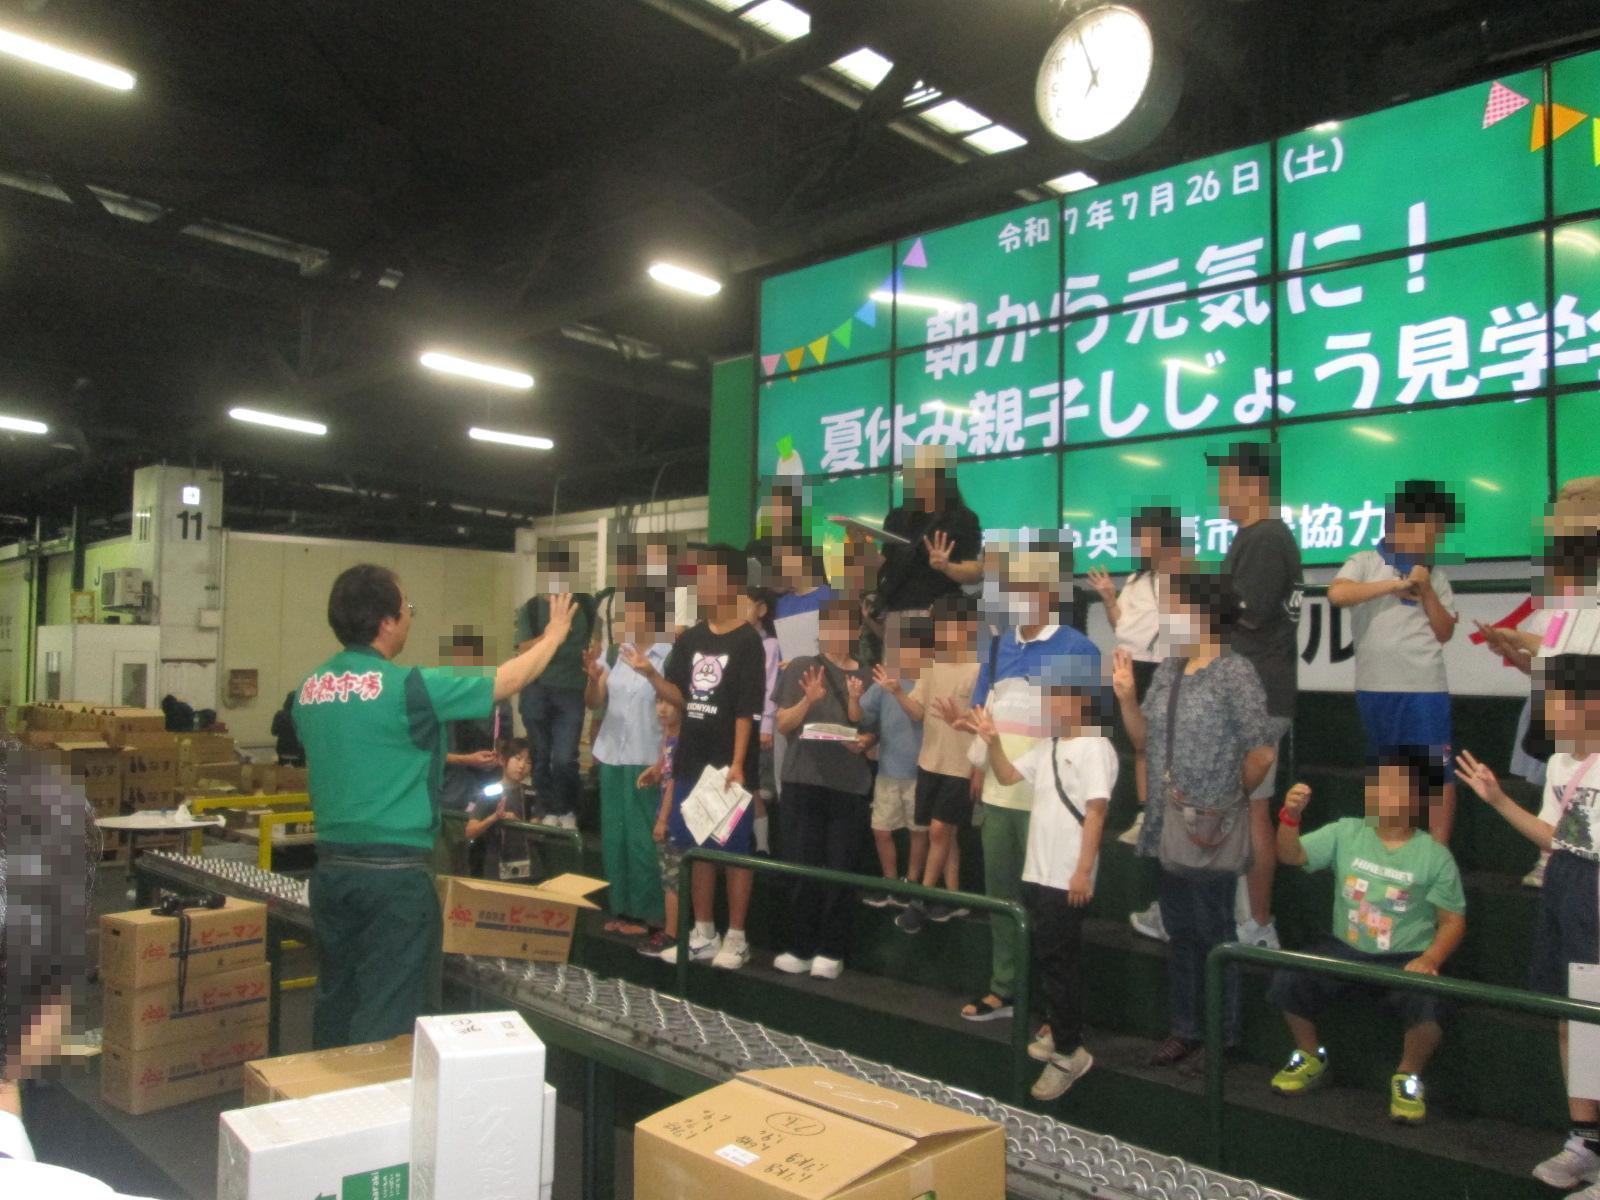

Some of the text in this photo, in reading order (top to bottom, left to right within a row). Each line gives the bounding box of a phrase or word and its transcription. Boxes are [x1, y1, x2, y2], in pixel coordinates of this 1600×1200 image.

[820, 294, 1600, 482] 夏休み親子しじょう見学
[177, 510, 202, 541] 11
[509, 905, 570, 929] ピーマン
[201, 924, 262, 944] ピーマン
[203, 981, 265, 1006] ピーマン
